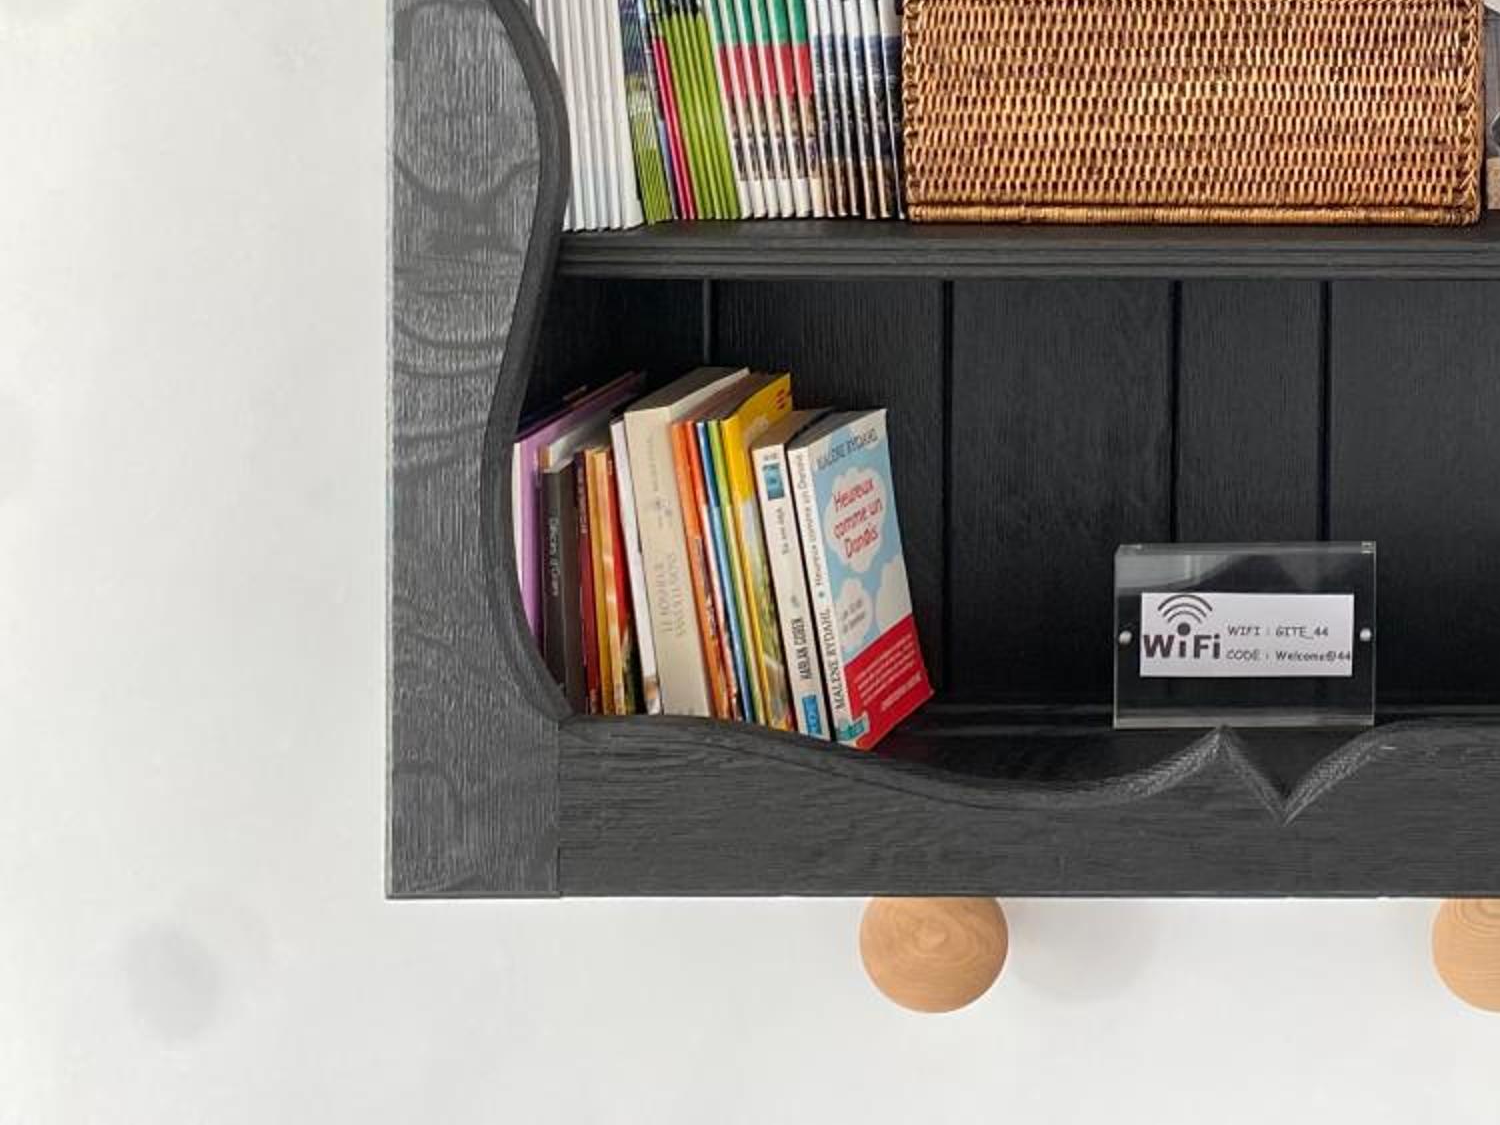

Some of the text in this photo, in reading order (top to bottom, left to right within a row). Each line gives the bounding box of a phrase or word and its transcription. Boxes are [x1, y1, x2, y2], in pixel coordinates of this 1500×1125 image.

[1227, 625, 1261, 637] WIFI
[1143, 623, 1221, 660] WiFi
[1226, 649, 1260, 660] CODE
